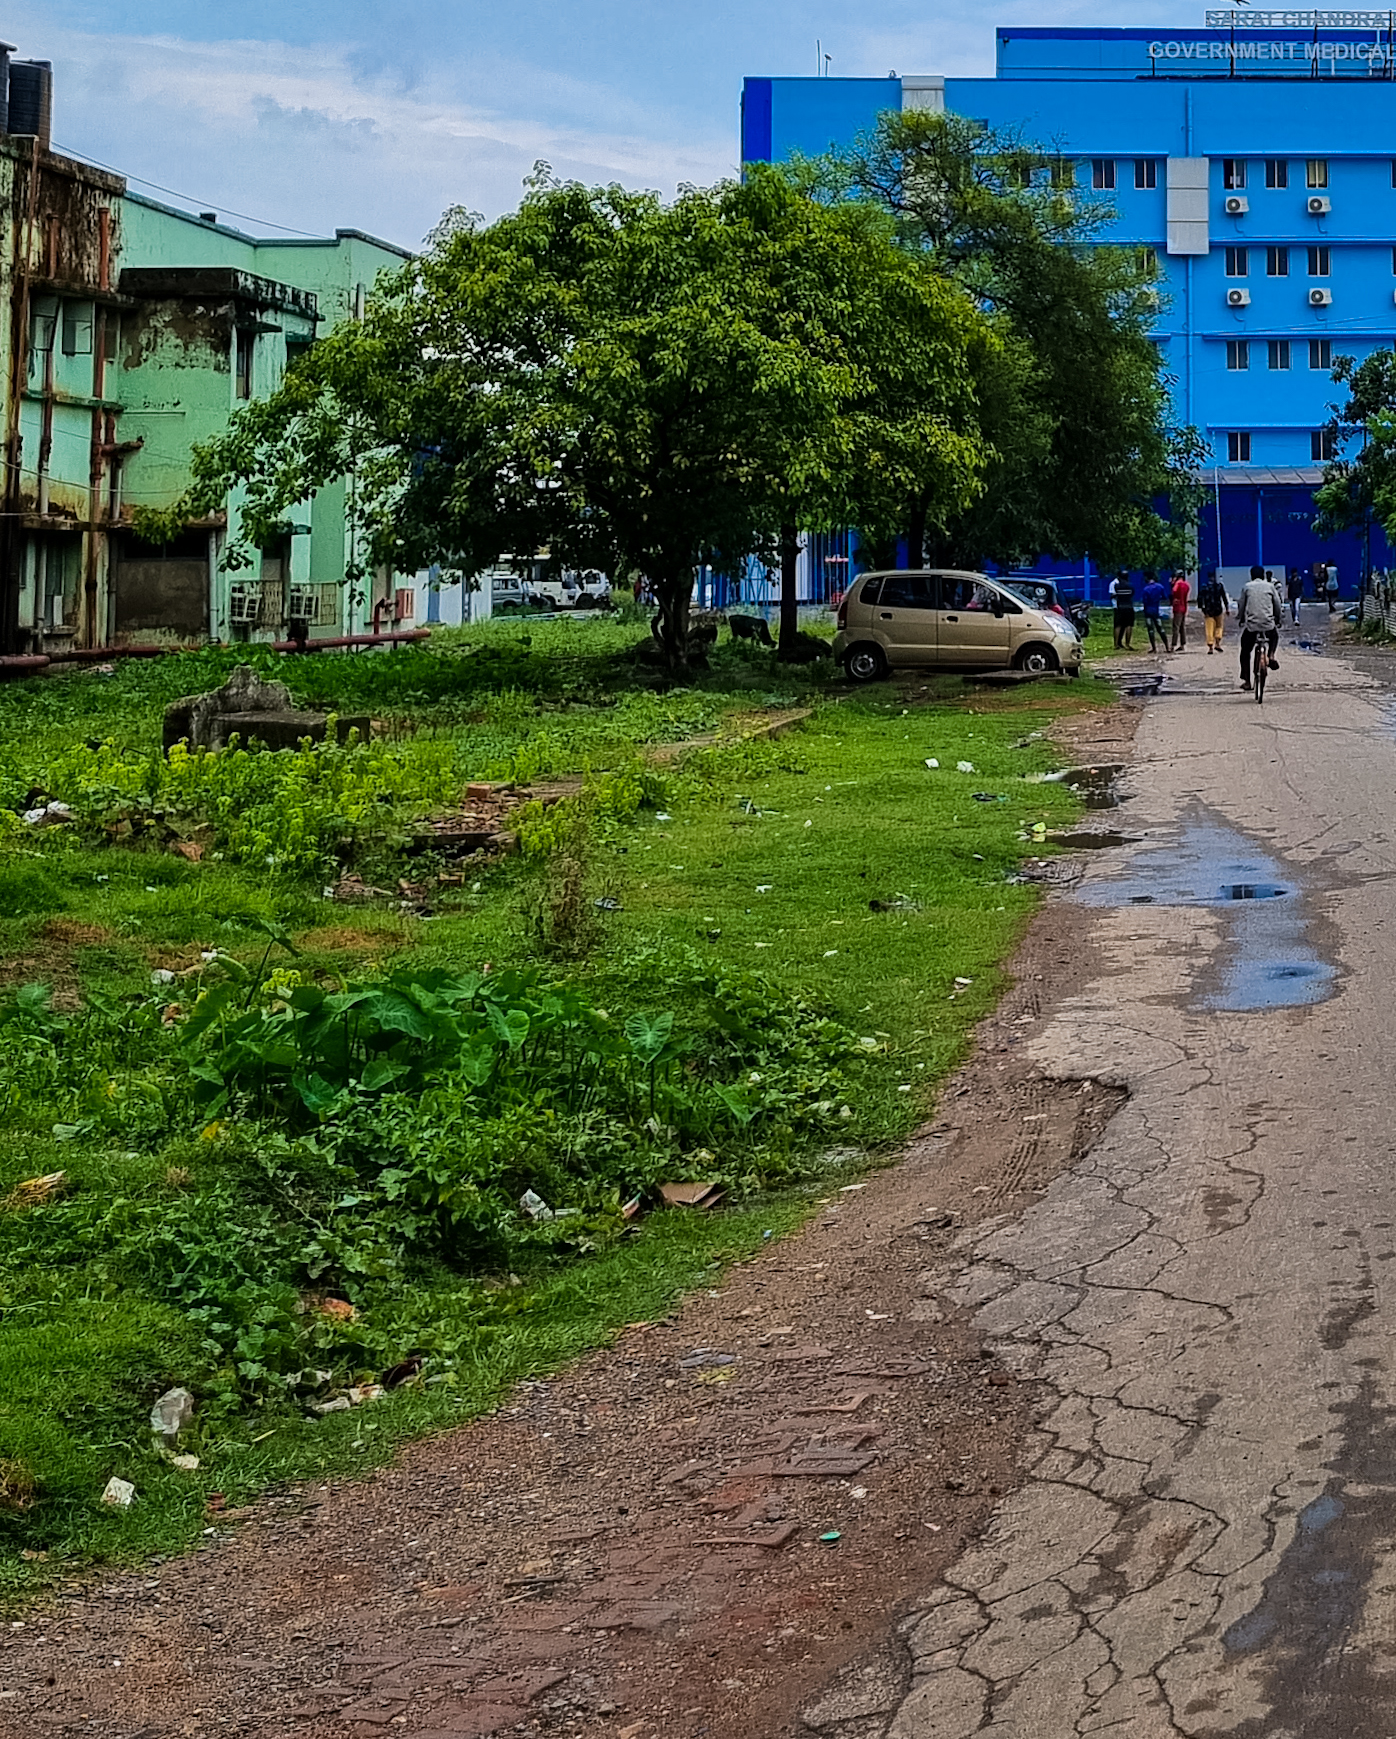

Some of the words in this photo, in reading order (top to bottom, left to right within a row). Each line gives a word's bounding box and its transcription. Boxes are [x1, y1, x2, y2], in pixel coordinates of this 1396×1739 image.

[1207, 11, 1277, 27] SARAT
[1281, 12, 1387, 28] CHANDRA
[1149, 41, 1298, 59] GOVERNMENT
[1304, 42, 1396, 60] MEDICAL
